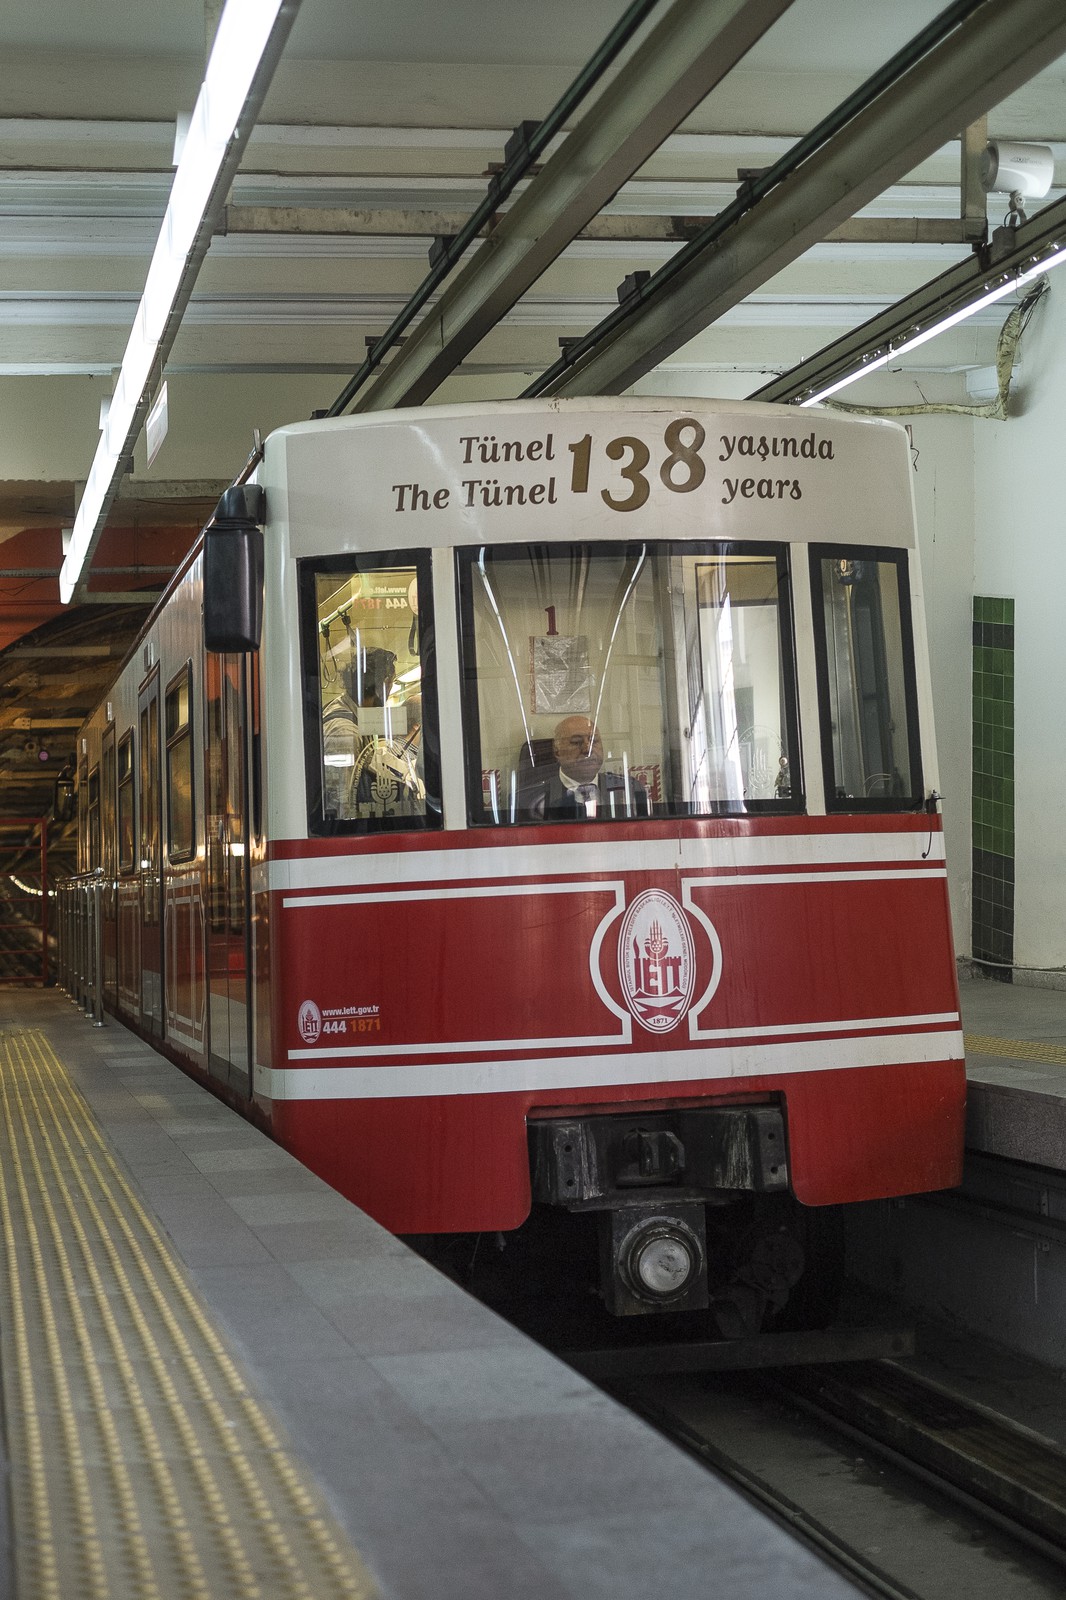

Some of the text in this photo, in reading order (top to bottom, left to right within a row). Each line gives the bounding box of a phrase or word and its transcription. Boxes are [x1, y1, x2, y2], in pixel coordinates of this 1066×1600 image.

[460, 417, 835, 513] Tünel 138 yaşında
[392, 475, 802, 513] The Tünel years
[544, 605, 559, 635] 1
[322, 1005, 380, 1016] www.iett.gov.tr
[322, 1018, 381, 1034] 444 1871
